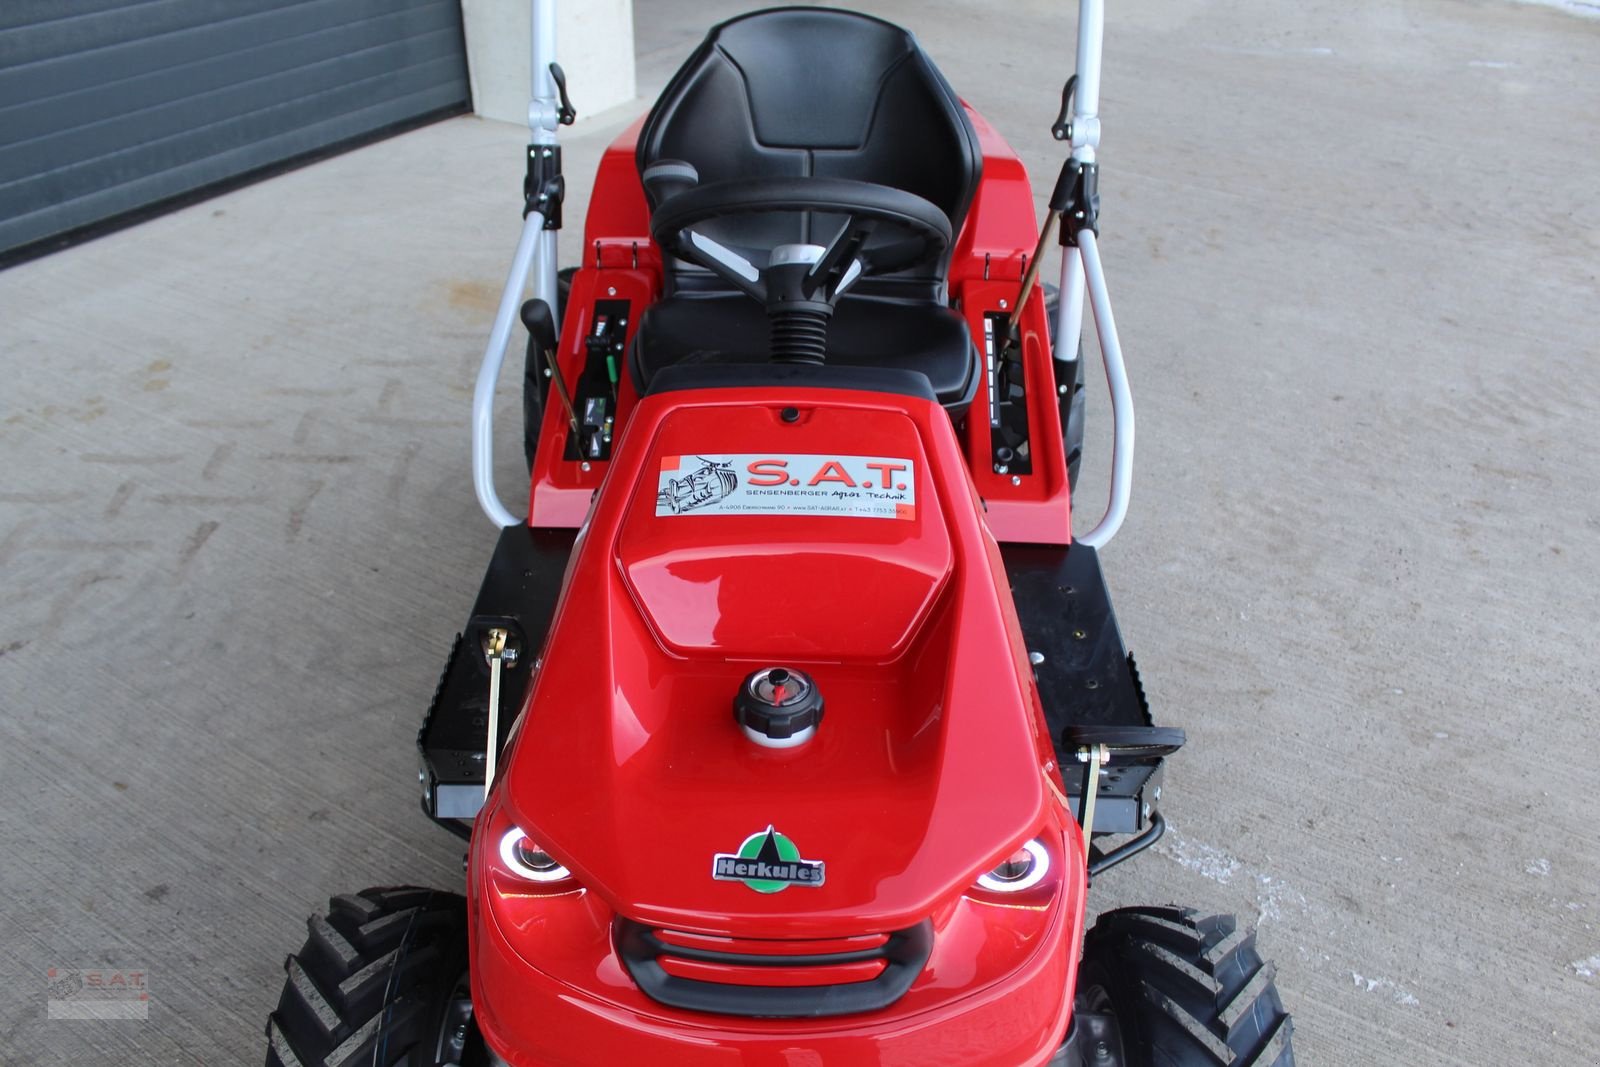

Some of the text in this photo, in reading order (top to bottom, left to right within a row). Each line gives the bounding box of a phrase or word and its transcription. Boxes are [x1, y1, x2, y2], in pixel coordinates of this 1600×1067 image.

[747, 459, 907, 490] S.A.T.
[831, 490, 861, 499] Agrar
[866, 491, 906, 500] Technik
[717, 859, 822, 881] Herkules
